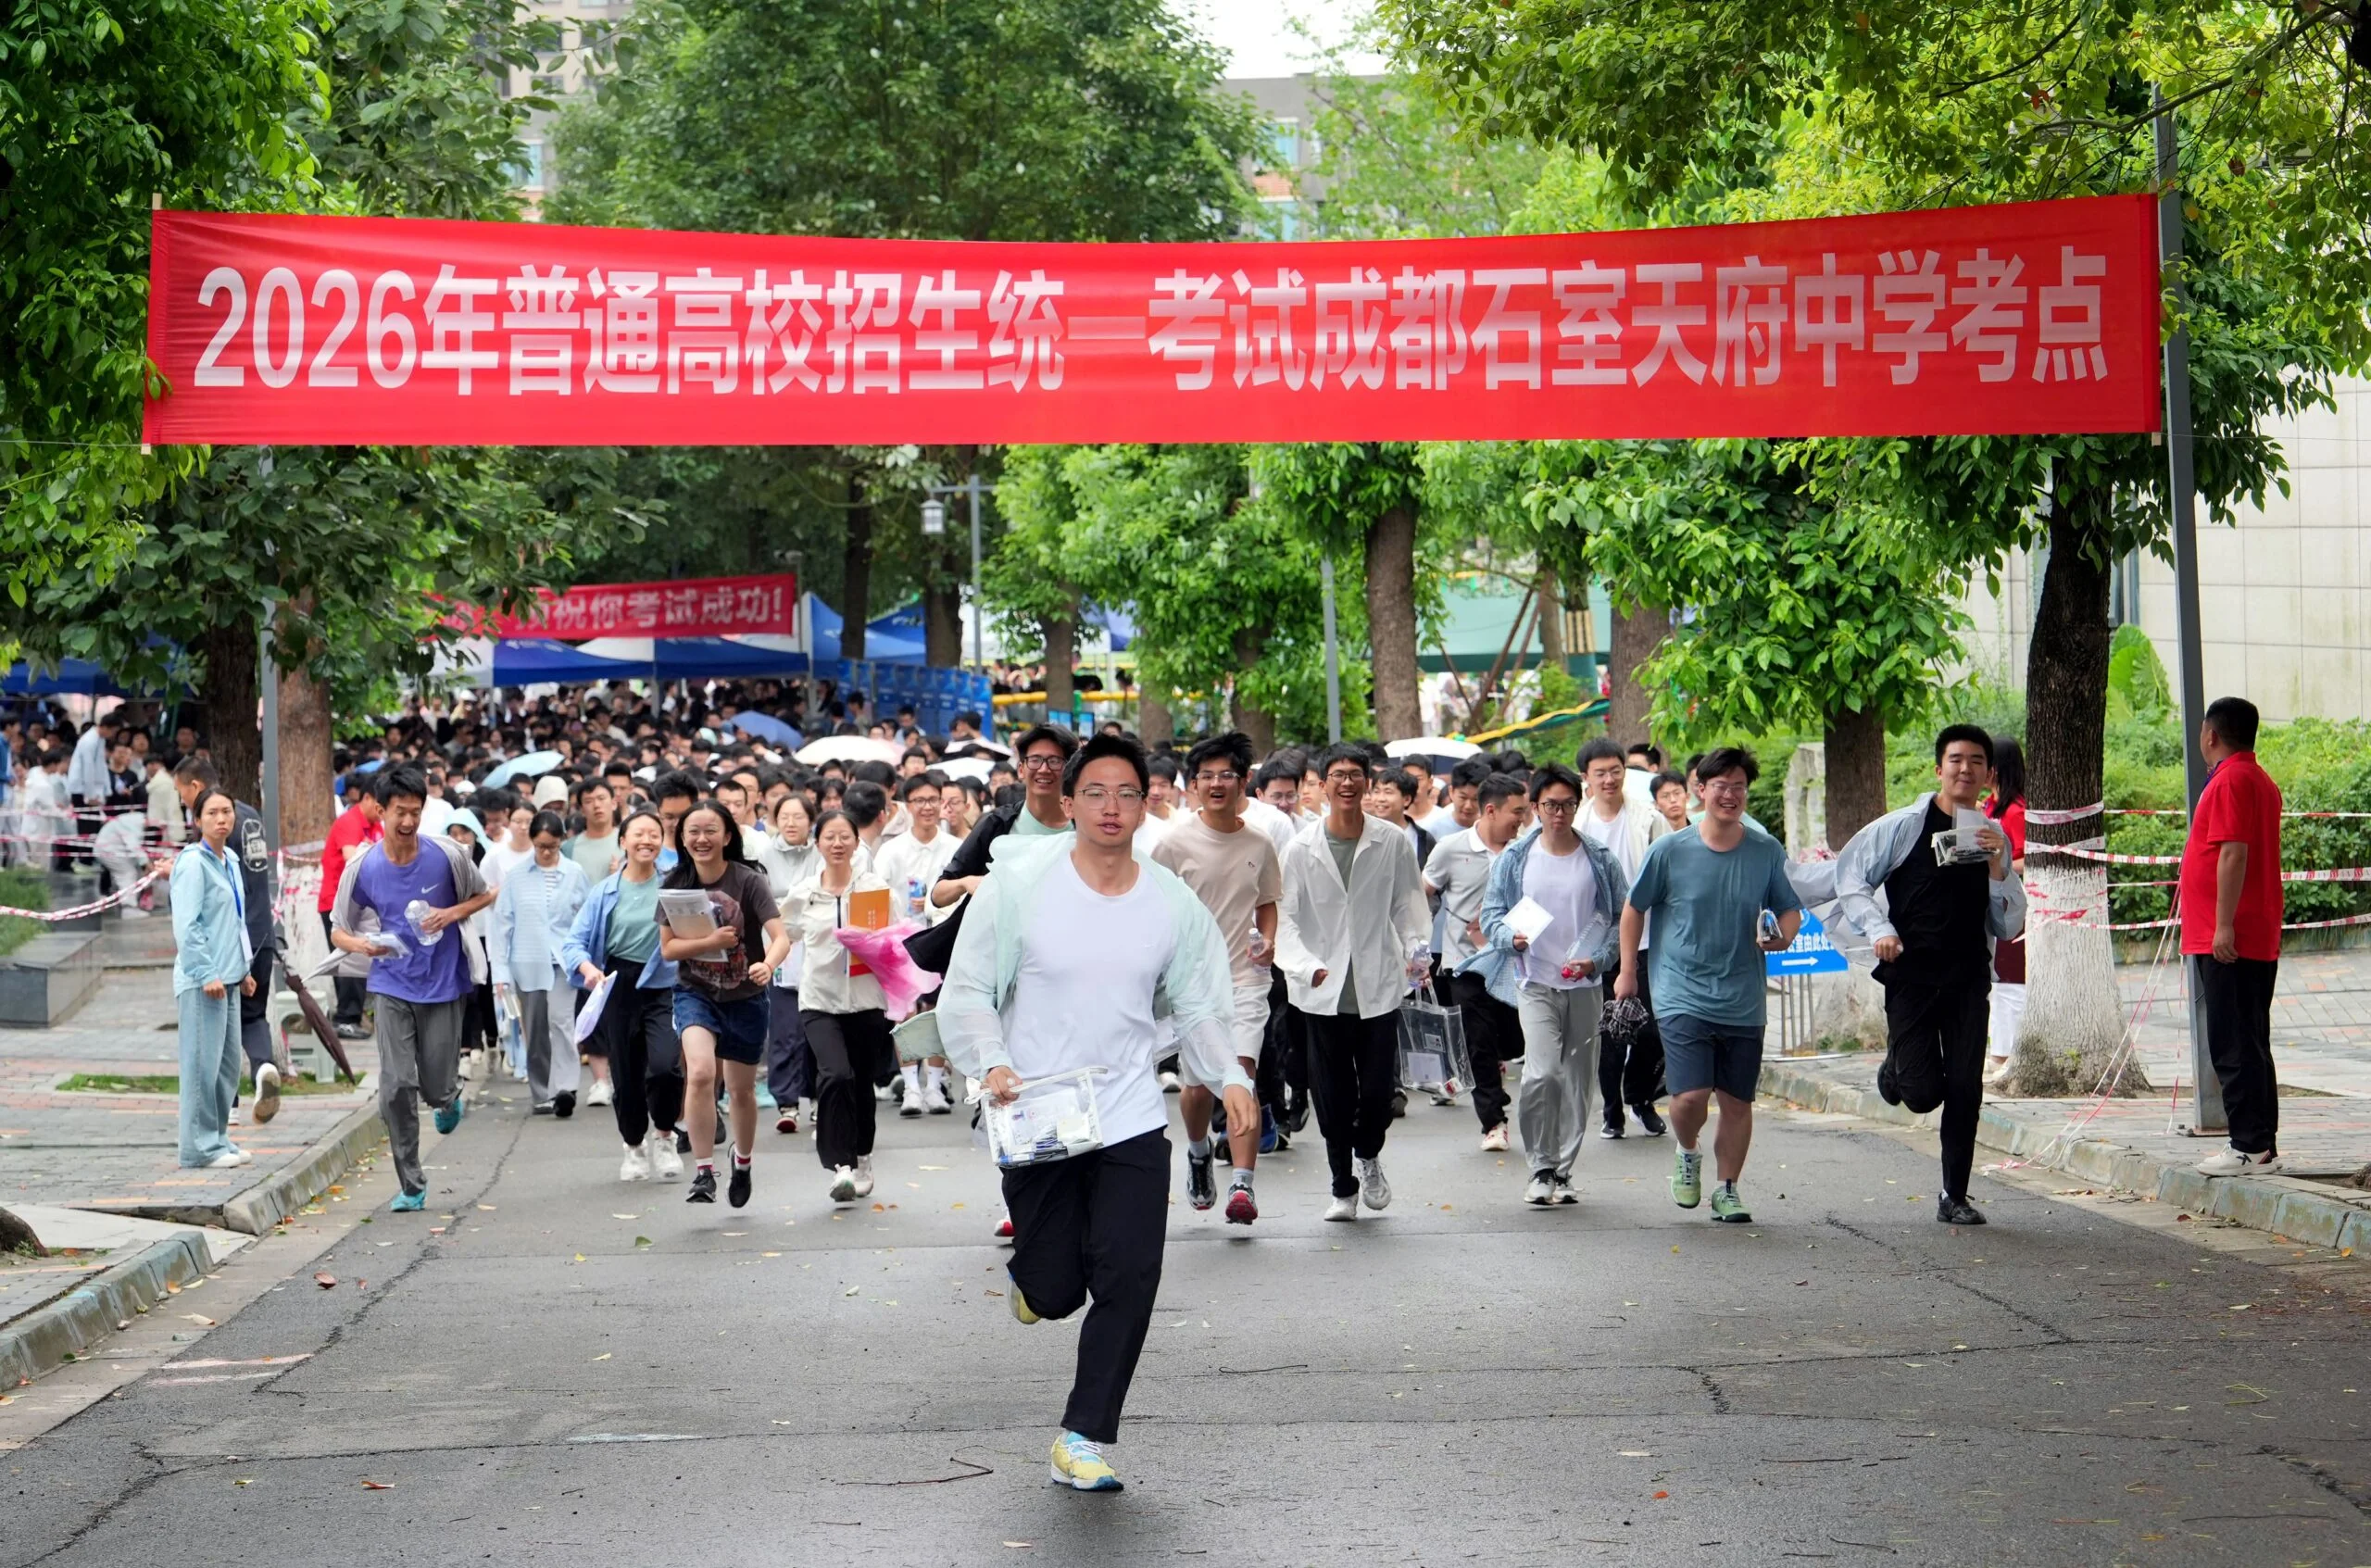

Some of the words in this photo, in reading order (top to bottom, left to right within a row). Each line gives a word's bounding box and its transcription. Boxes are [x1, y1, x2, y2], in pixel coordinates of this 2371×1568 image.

[194, 245, 2108, 396] 2026年普通高校招生统一考试成都石室天府中学考点
